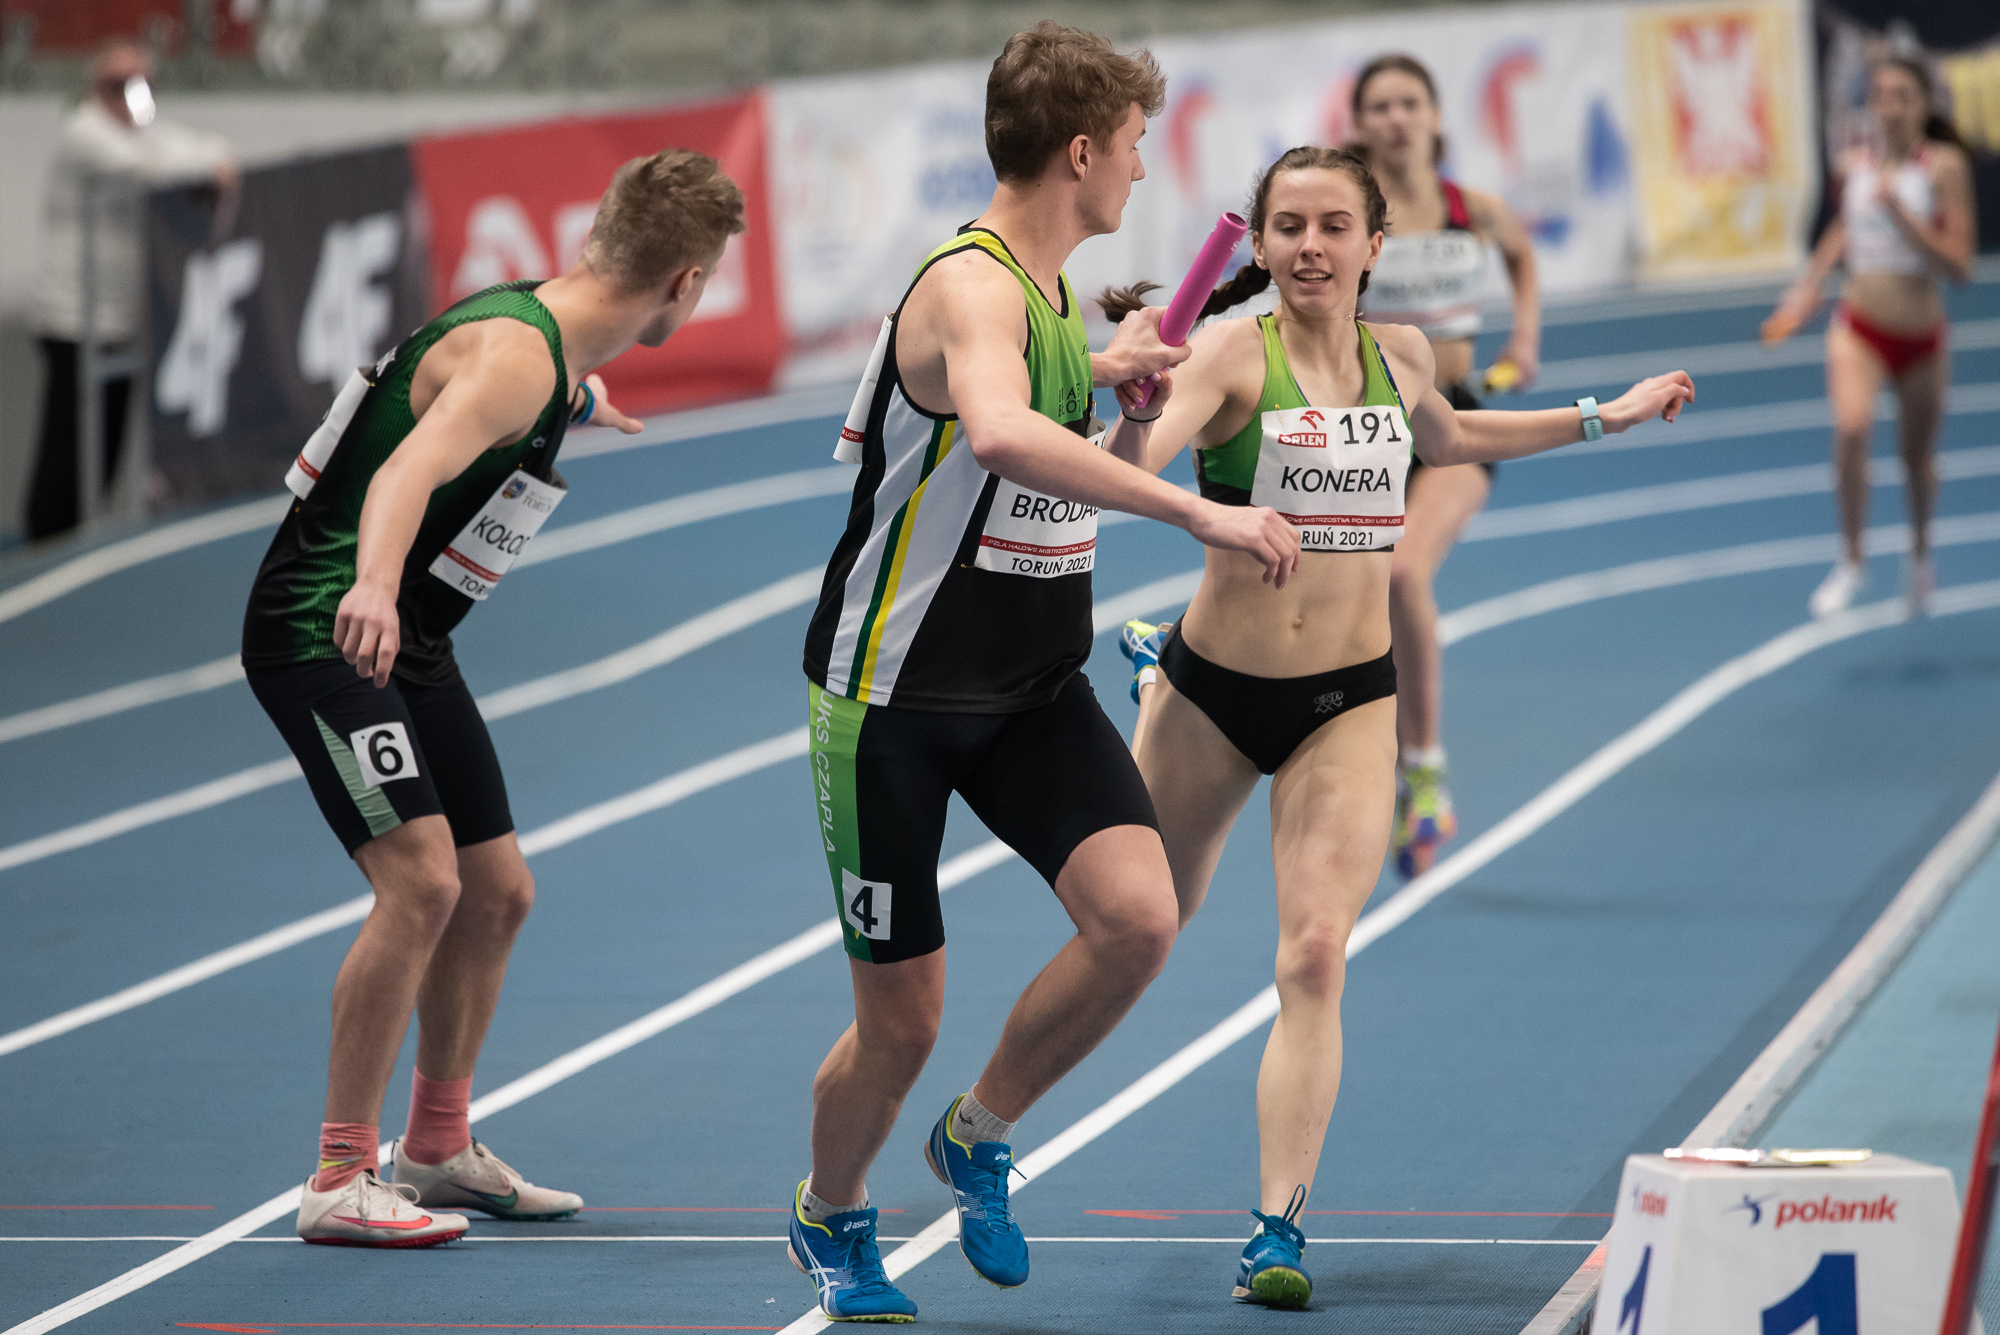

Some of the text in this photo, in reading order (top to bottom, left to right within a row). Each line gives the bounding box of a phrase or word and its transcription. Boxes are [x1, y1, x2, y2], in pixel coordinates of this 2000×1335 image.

[156, 238, 263, 438] 4F
[1280, 434, 1326, 447] ORLEN
[1339, 411, 1402, 445] 191
[1280, 465, 1392, 493] KONERA
[1301, 527, 1373, 546] RUŃ 2021
[1352, 517, 1375, 525] POLSKI
[987, 539, 1008, 548] PZLA
[1008, 543, 1038, 553] HALOWE
[1038, 545, 1080, 555] MISTRZOSTWA
[1011, 554, 1092, 575] TORUŃ 2021
[368, 729, 404, 777] 6
[815, 689, 836, 852] UKS CZAPLA
[850, 885, 879, 935] 4
[851, 1219, 870, 1230] asics
[1774, 1194, 1898, 1230] polanik
[1760, 1251, 1859, 1335] 1
